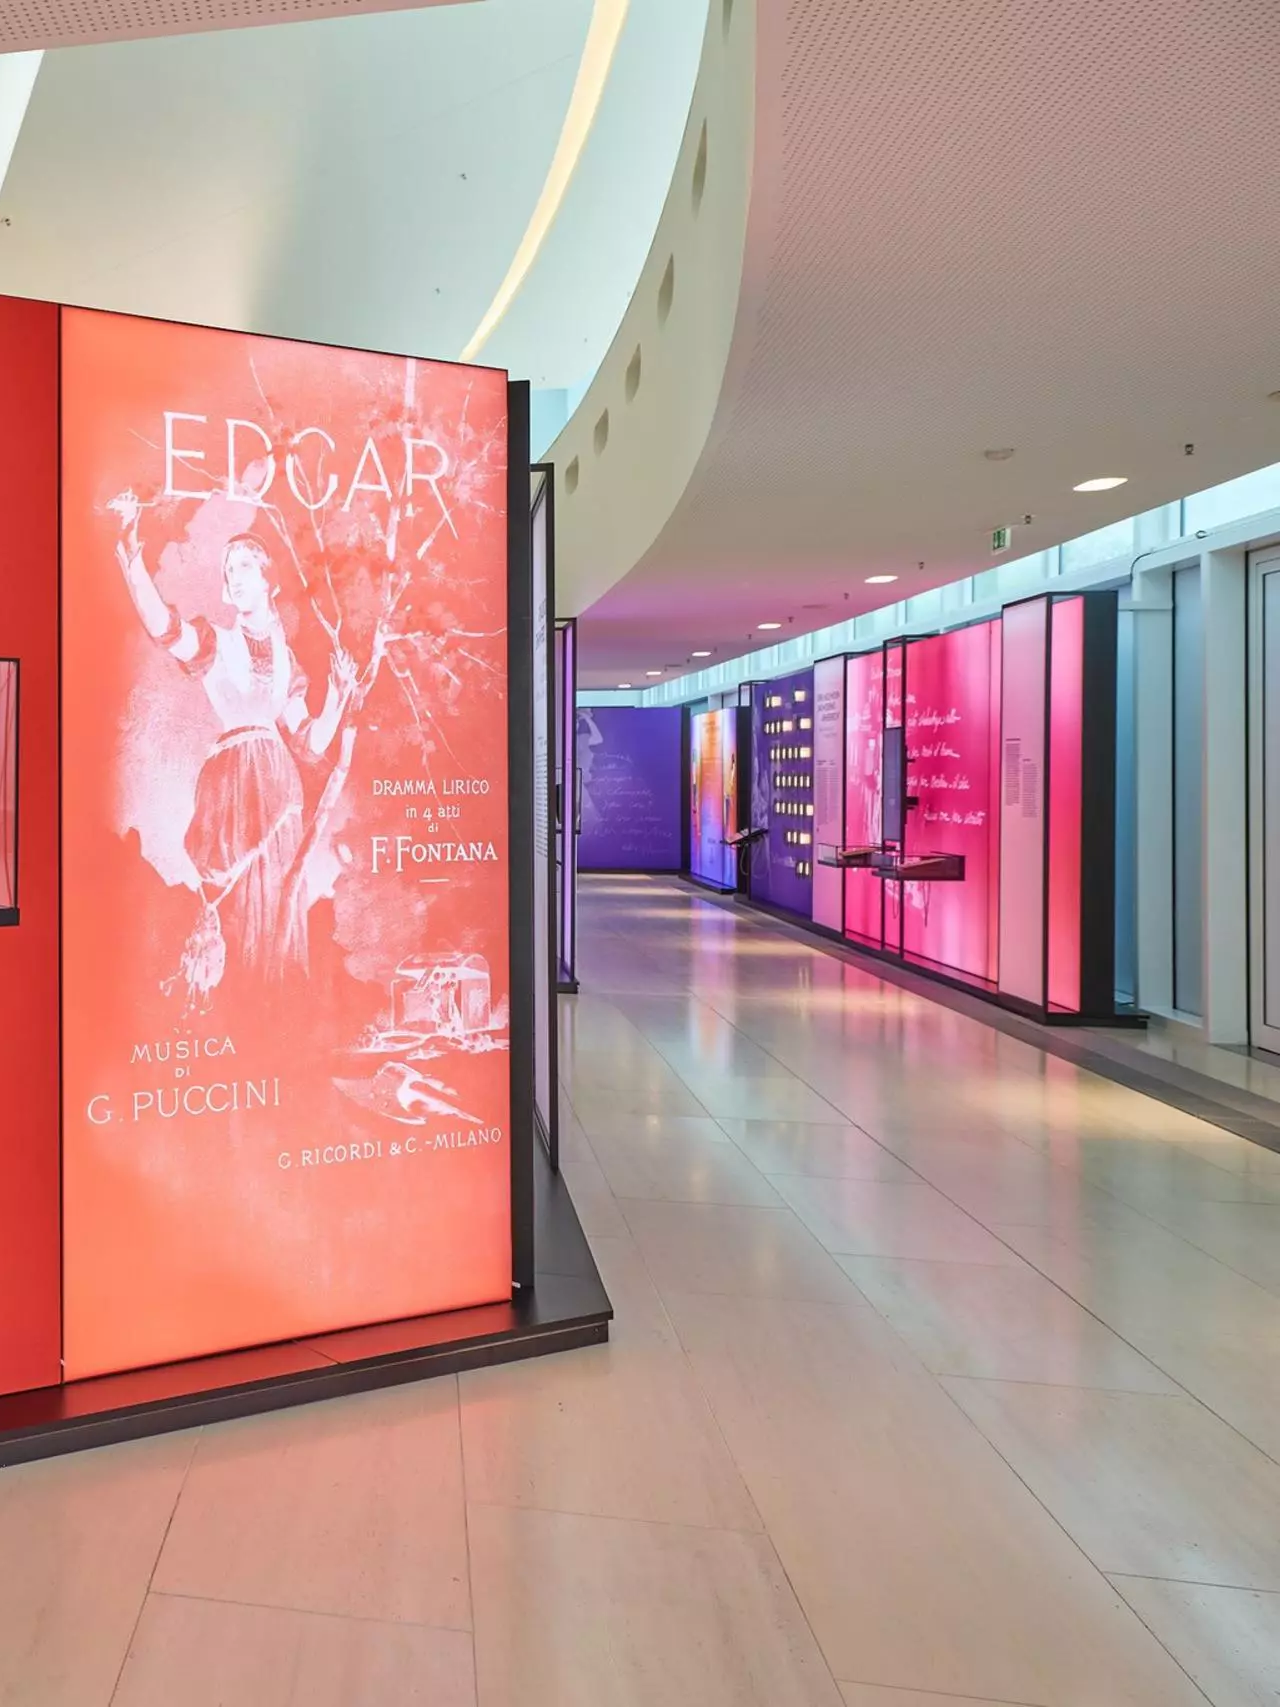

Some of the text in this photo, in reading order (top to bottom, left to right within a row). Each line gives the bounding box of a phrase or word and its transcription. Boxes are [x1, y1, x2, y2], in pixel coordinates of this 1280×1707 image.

[372, 778, 490, 796] DRAMMA LIRICO
[405, 803, 461, 821] in 4 atti
[427, 822, 439, 833] di
[129, 1036, 236, 1063] MUSICA
[174, 1065, 192, 1078] DI
[86, 1077, 279, 1125] G. PUCCINI
[388, 1142, 402, 1156] &
